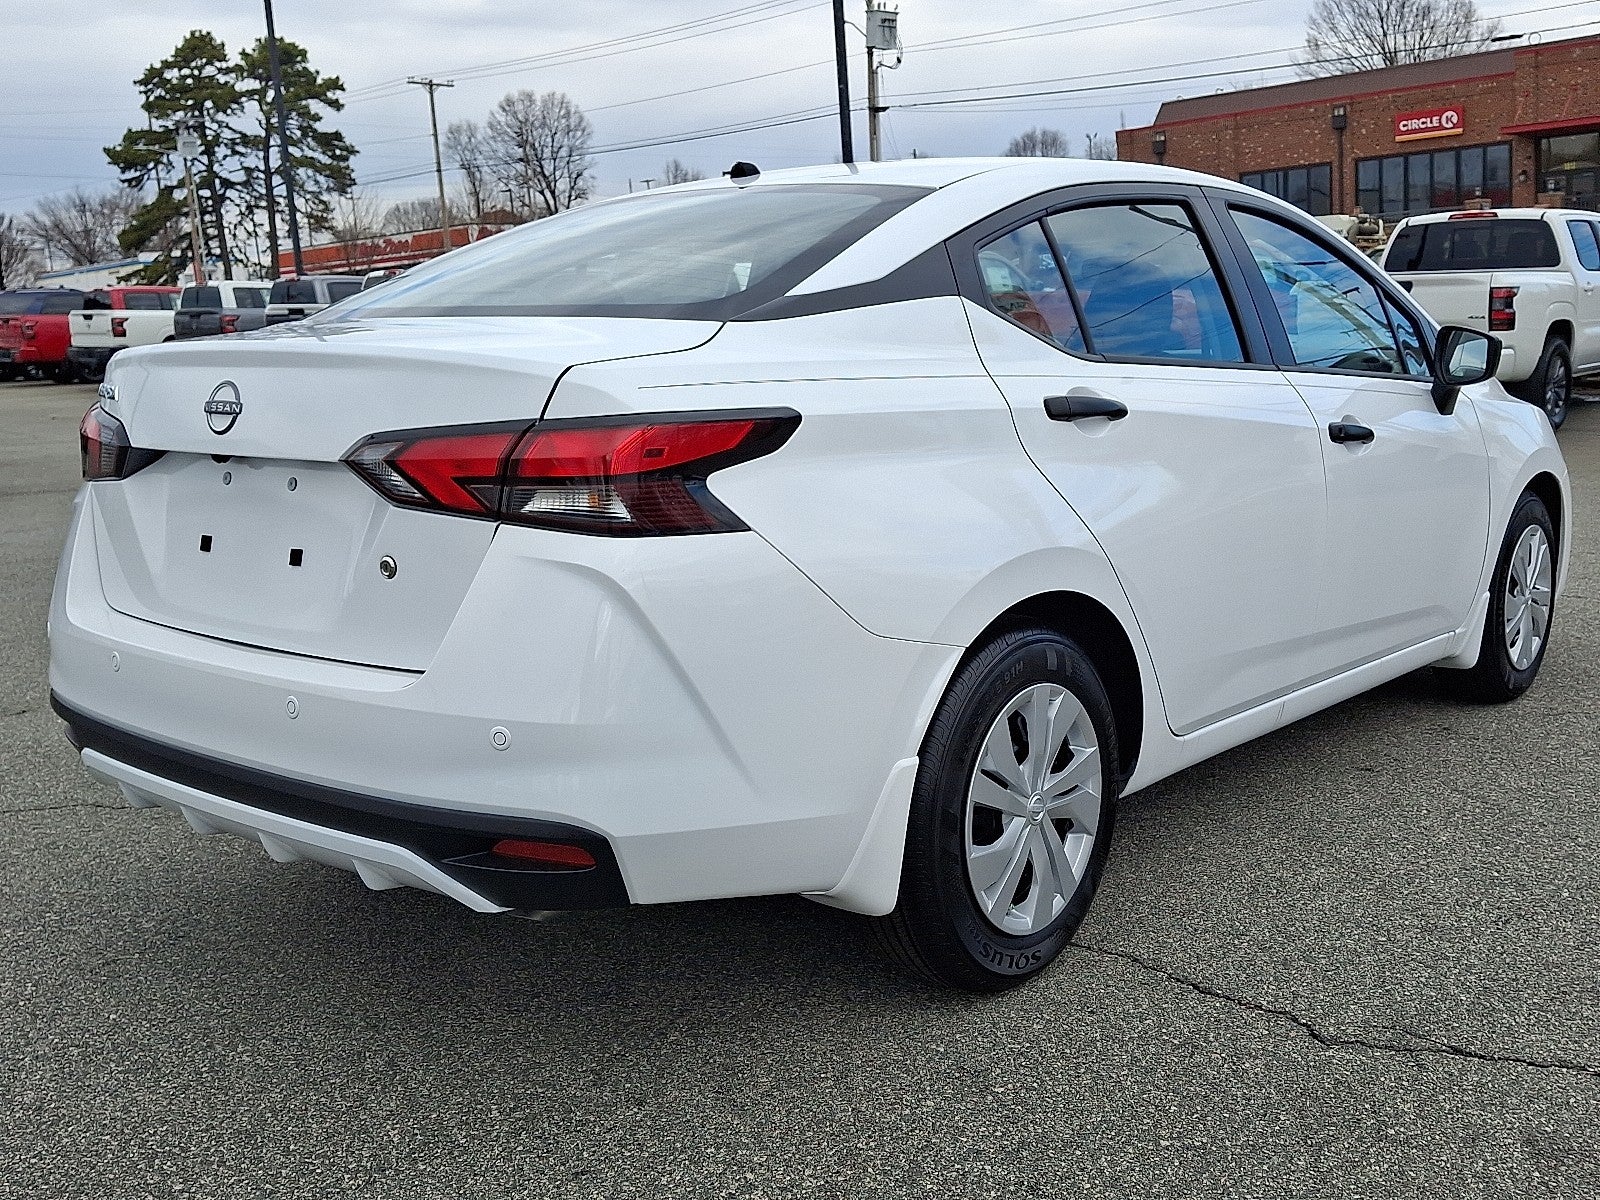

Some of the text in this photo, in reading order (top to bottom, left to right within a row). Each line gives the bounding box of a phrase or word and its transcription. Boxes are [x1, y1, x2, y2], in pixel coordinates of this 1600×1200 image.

[1399, 110, 1458, 131] CIRCLE K
[205, 402, 241, 413] NISSAN
[979, 942, 1042, 970] SOLUS
